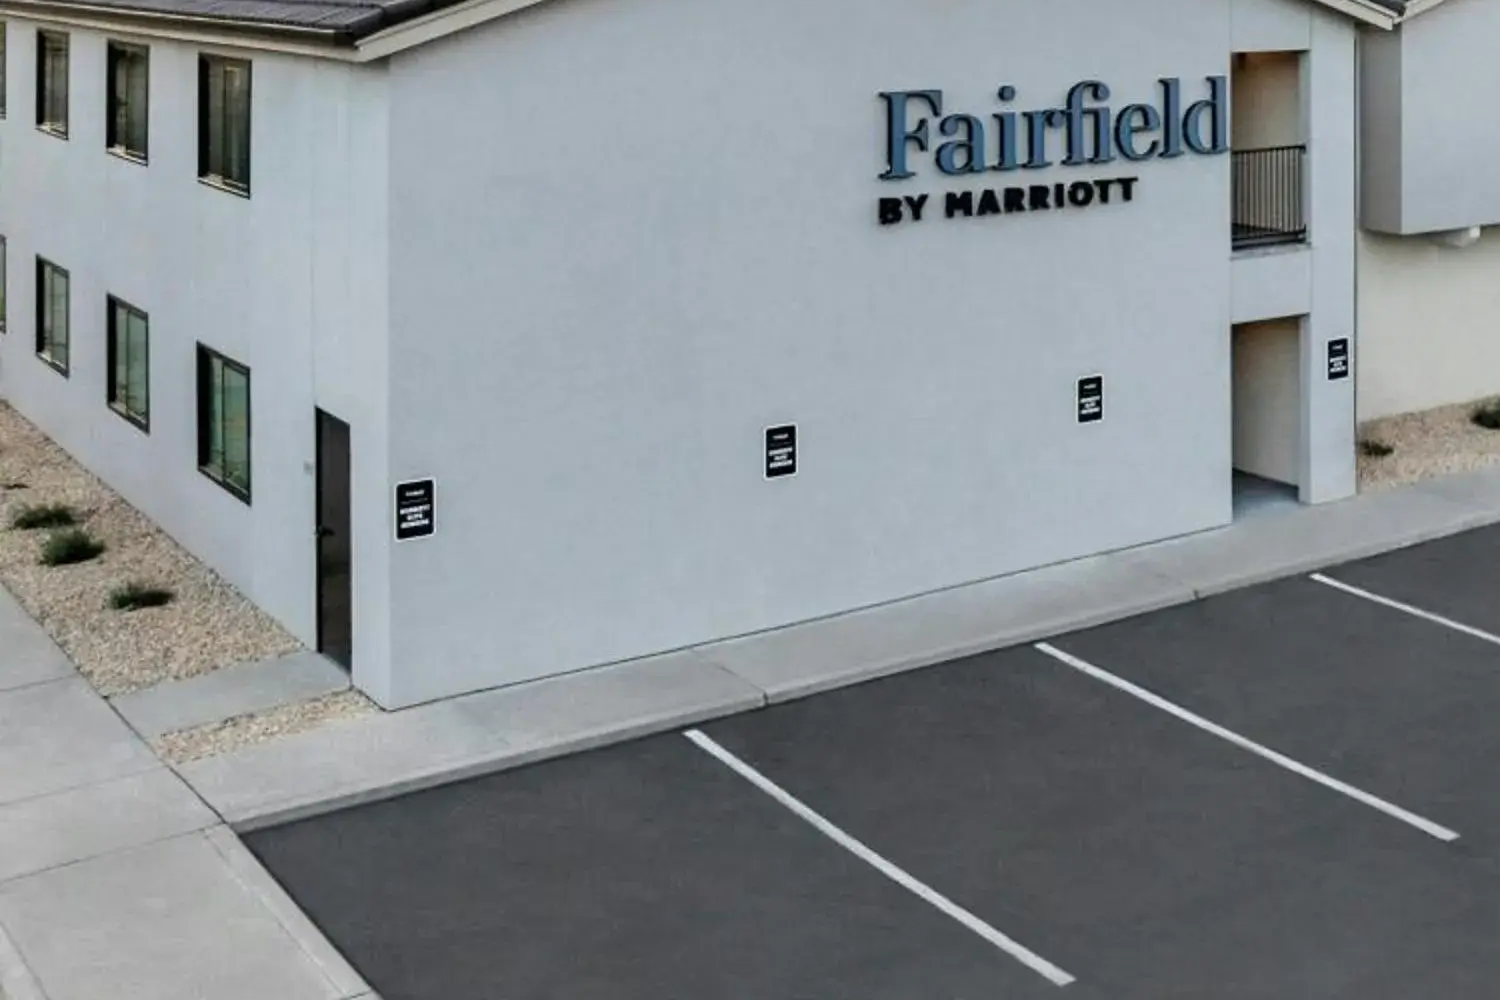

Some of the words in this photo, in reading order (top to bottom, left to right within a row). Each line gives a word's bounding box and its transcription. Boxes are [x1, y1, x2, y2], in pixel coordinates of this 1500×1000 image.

[878, 75, 1230, 181] Fairfield
[879, 193, 929, 225] BY
[945, 177, 1139, 218] MARRIOTT
